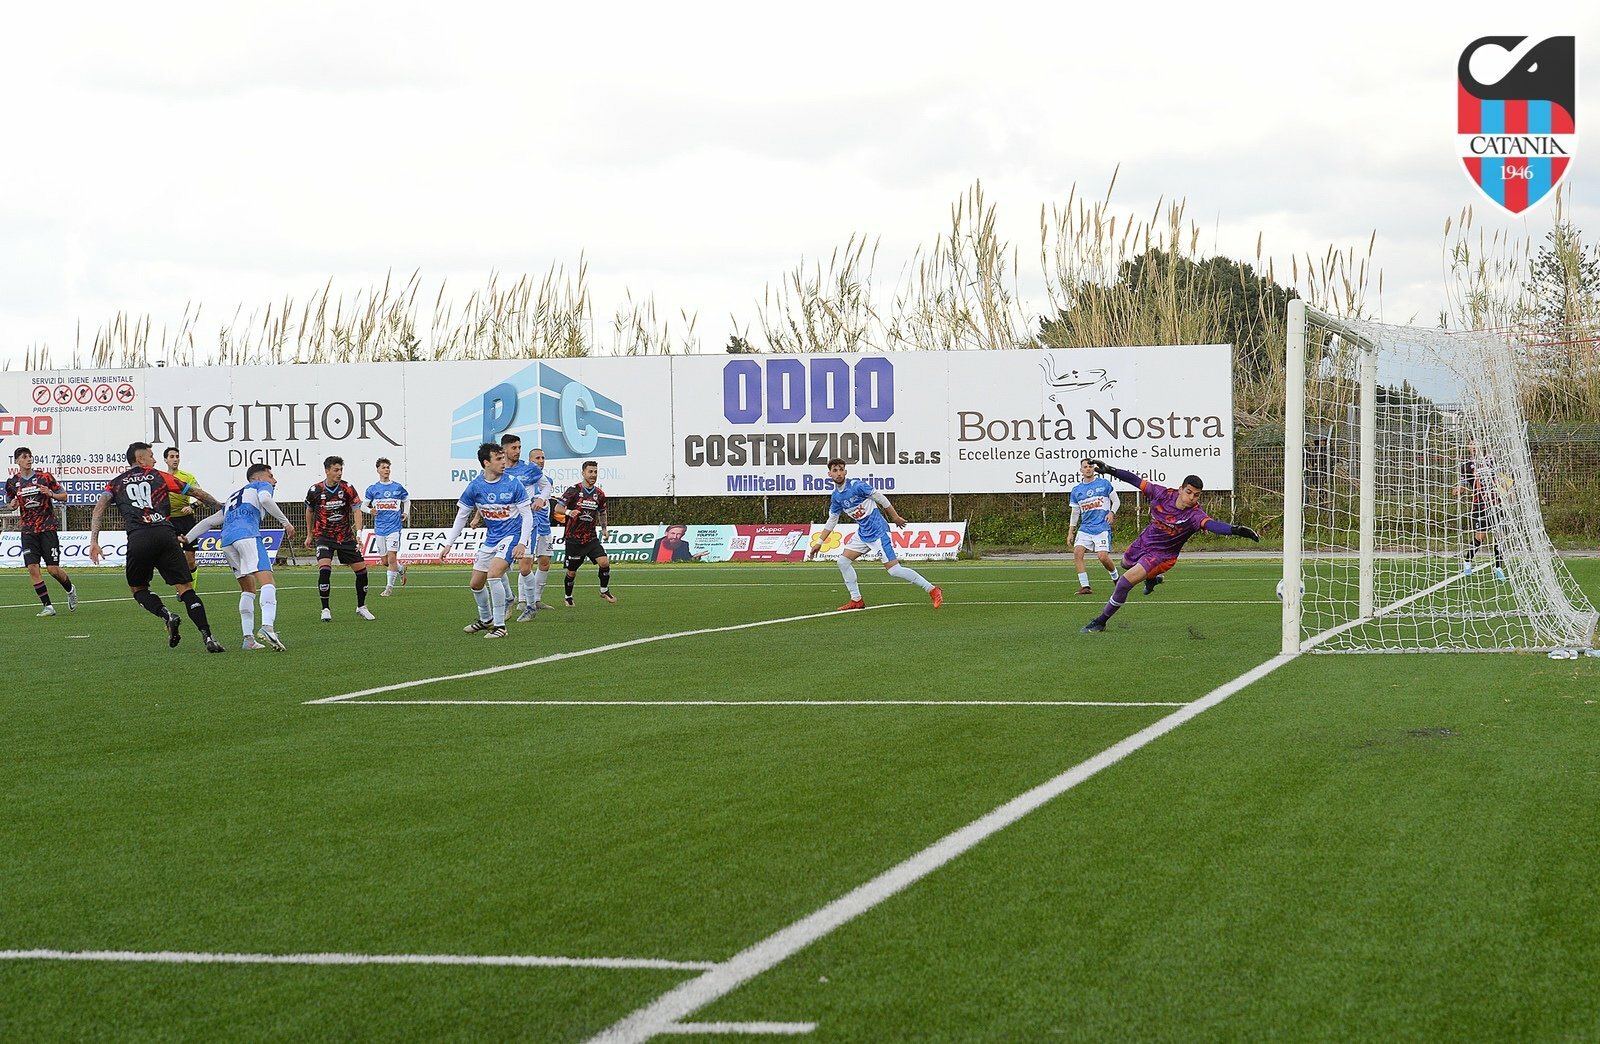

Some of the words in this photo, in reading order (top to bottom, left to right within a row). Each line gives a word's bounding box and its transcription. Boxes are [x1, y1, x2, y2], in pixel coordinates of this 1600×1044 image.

[32, 377, 56, 385] SERVIZI
[68, 376, 89, 384] IGIENE
[723, 357, 895, 425] ODDO
[33, 405, 134, 413] PROFESSIONAL-PEST-CONTROL
[151, 401, 402, 447] NIGITHOR
[957, 403, 1076, 442] Bontà
[1086, 407, 1225, 440] Nostra
[89, 453, 103, 463] 339
[228, 448, 306, 468] DIGITAL
[684, 432, 896, 467] COSTRUZIONI
[898, 450, 941, 465] s.a.s
[958, 448, 1031, 461] Eccellenze
[1034, 445, 1138, 460] Gastronomiche
[1151, 444, 1222, 458] Salumeria
[75, 481, 109, 491] CISTER
[727, 474, 796, 491] Militello
[1015, 471, 1085, 486] Sant'Agat
[126, 482, 154, 509] 99
[406, 532, 485, 540] GRAHI
[844, 530, 961, 549] NAD
[409, 543, 485, 551] CENTE
[607, 551, 649, 561] minio
